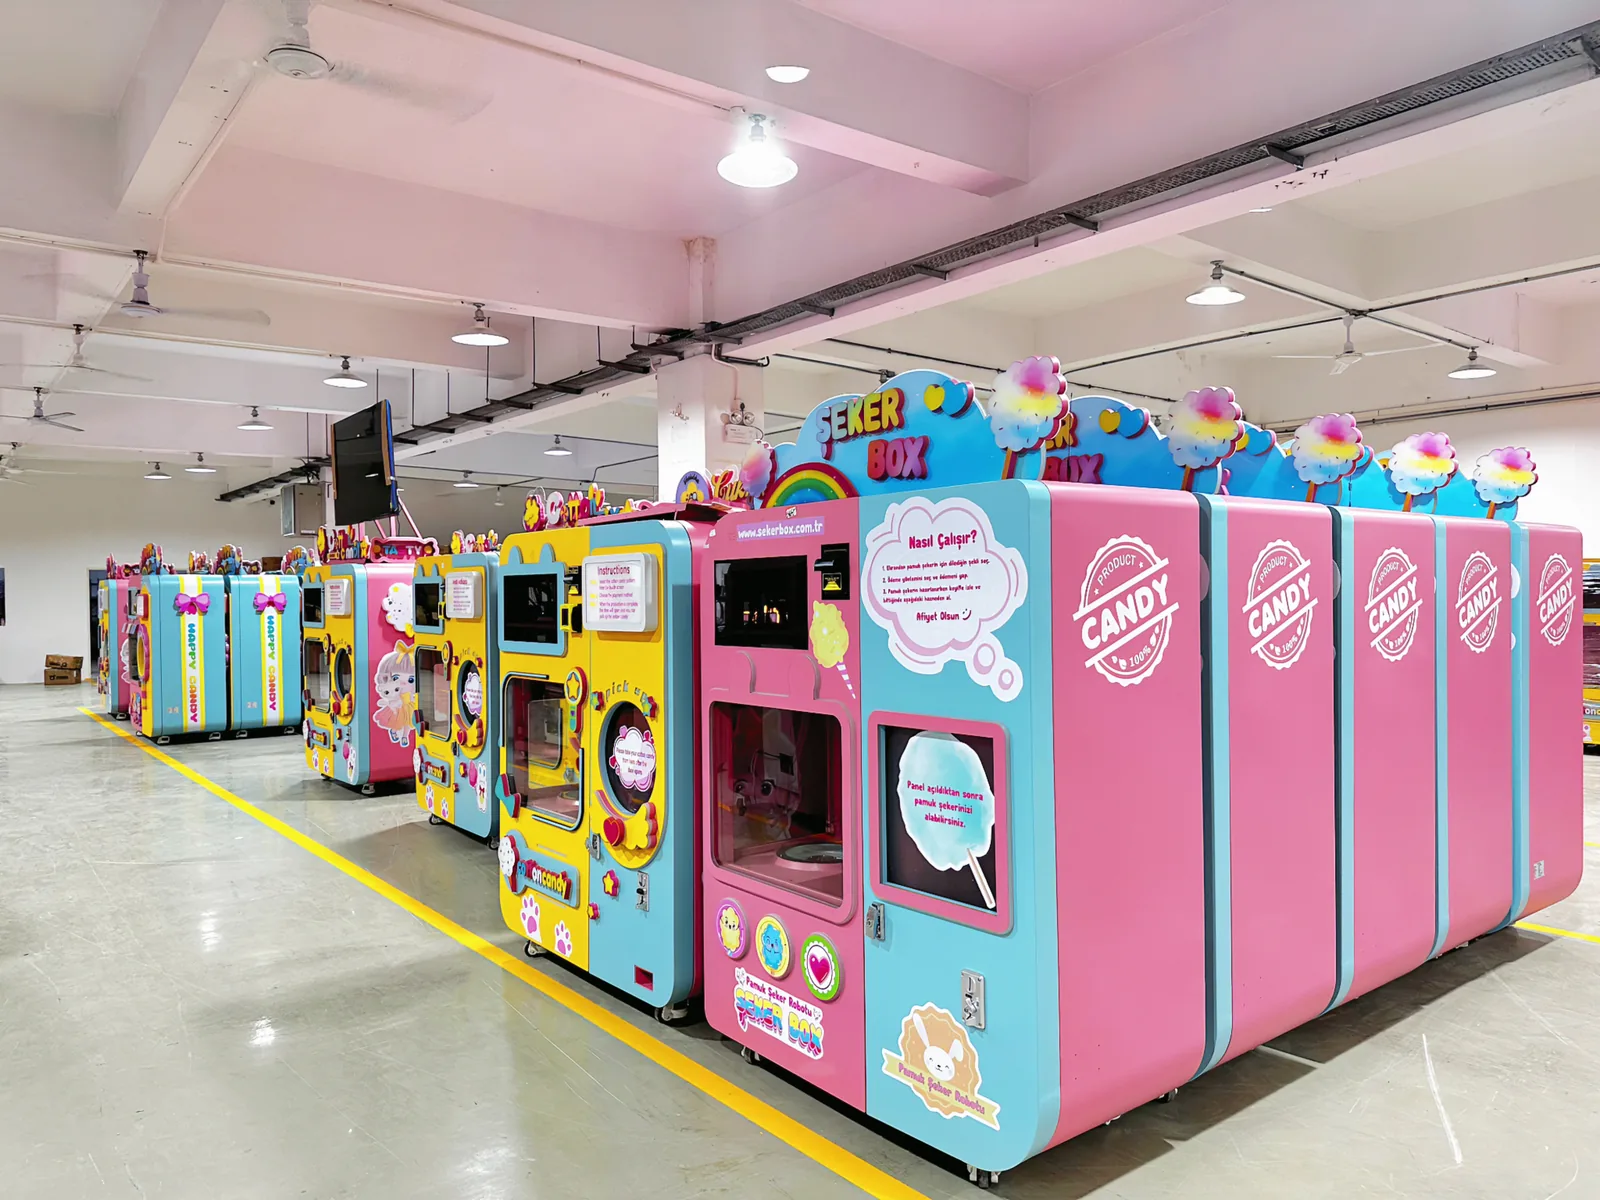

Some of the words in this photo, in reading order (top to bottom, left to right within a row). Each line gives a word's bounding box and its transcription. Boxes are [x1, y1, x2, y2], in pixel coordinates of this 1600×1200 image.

[867, 436, 929, 482] BOX
[738, 519, 823, 539] www.sekerbox.com.tr
[908, 534, 934, 550] Nasıl
[938, 530, 978, 550] Çalışır?
[598, 564, 630, 576] Instructions
[1097, 554, 1136, 586] PRODUCT
[1260, 556, 1288, 583] PRODUCT
[916, 612, 937, 623] Afiyet
[940, 611, 960, 620] Olsun
[1082, 573, 1168, 650] CANDY
[1248, 572, 1310, 638] CANDY
[1369, 576, 1417, 634] CANDY
[1459, 577, 1497, 628] CANDY
[1539, 577, 1572, 623] CANDY
[188, 623, 196, 669] HAPPY
[267, 615, 275, 660] HAPPY
[1130, 646, 1151, 667] 100%
[1282, 634, 1298, 653] 100%
[189, 675, 198, 722] CANDY
[268, 665, 276, 710] CANDY
[606, 680, 629, 702] pick
[907, 780, 925, 791] Panel
[927, 785, 960, 797] açıldıktan
[962, 791, 983, 801] sonra
[914, 797, 936, 808] pamuk
[939, 802, 973, 814] şekerinizi
[924, 813, 966, 828] alabilirsiniz.
[746, 976, 766, 994] Pamuk
[789, 996, 812, 1017] Robotu
[788, 1012, 822, 1056] BOX
[898, 1062, 925, 1085] Pamuk
[955, 1090, 985, 1115] Robotu
